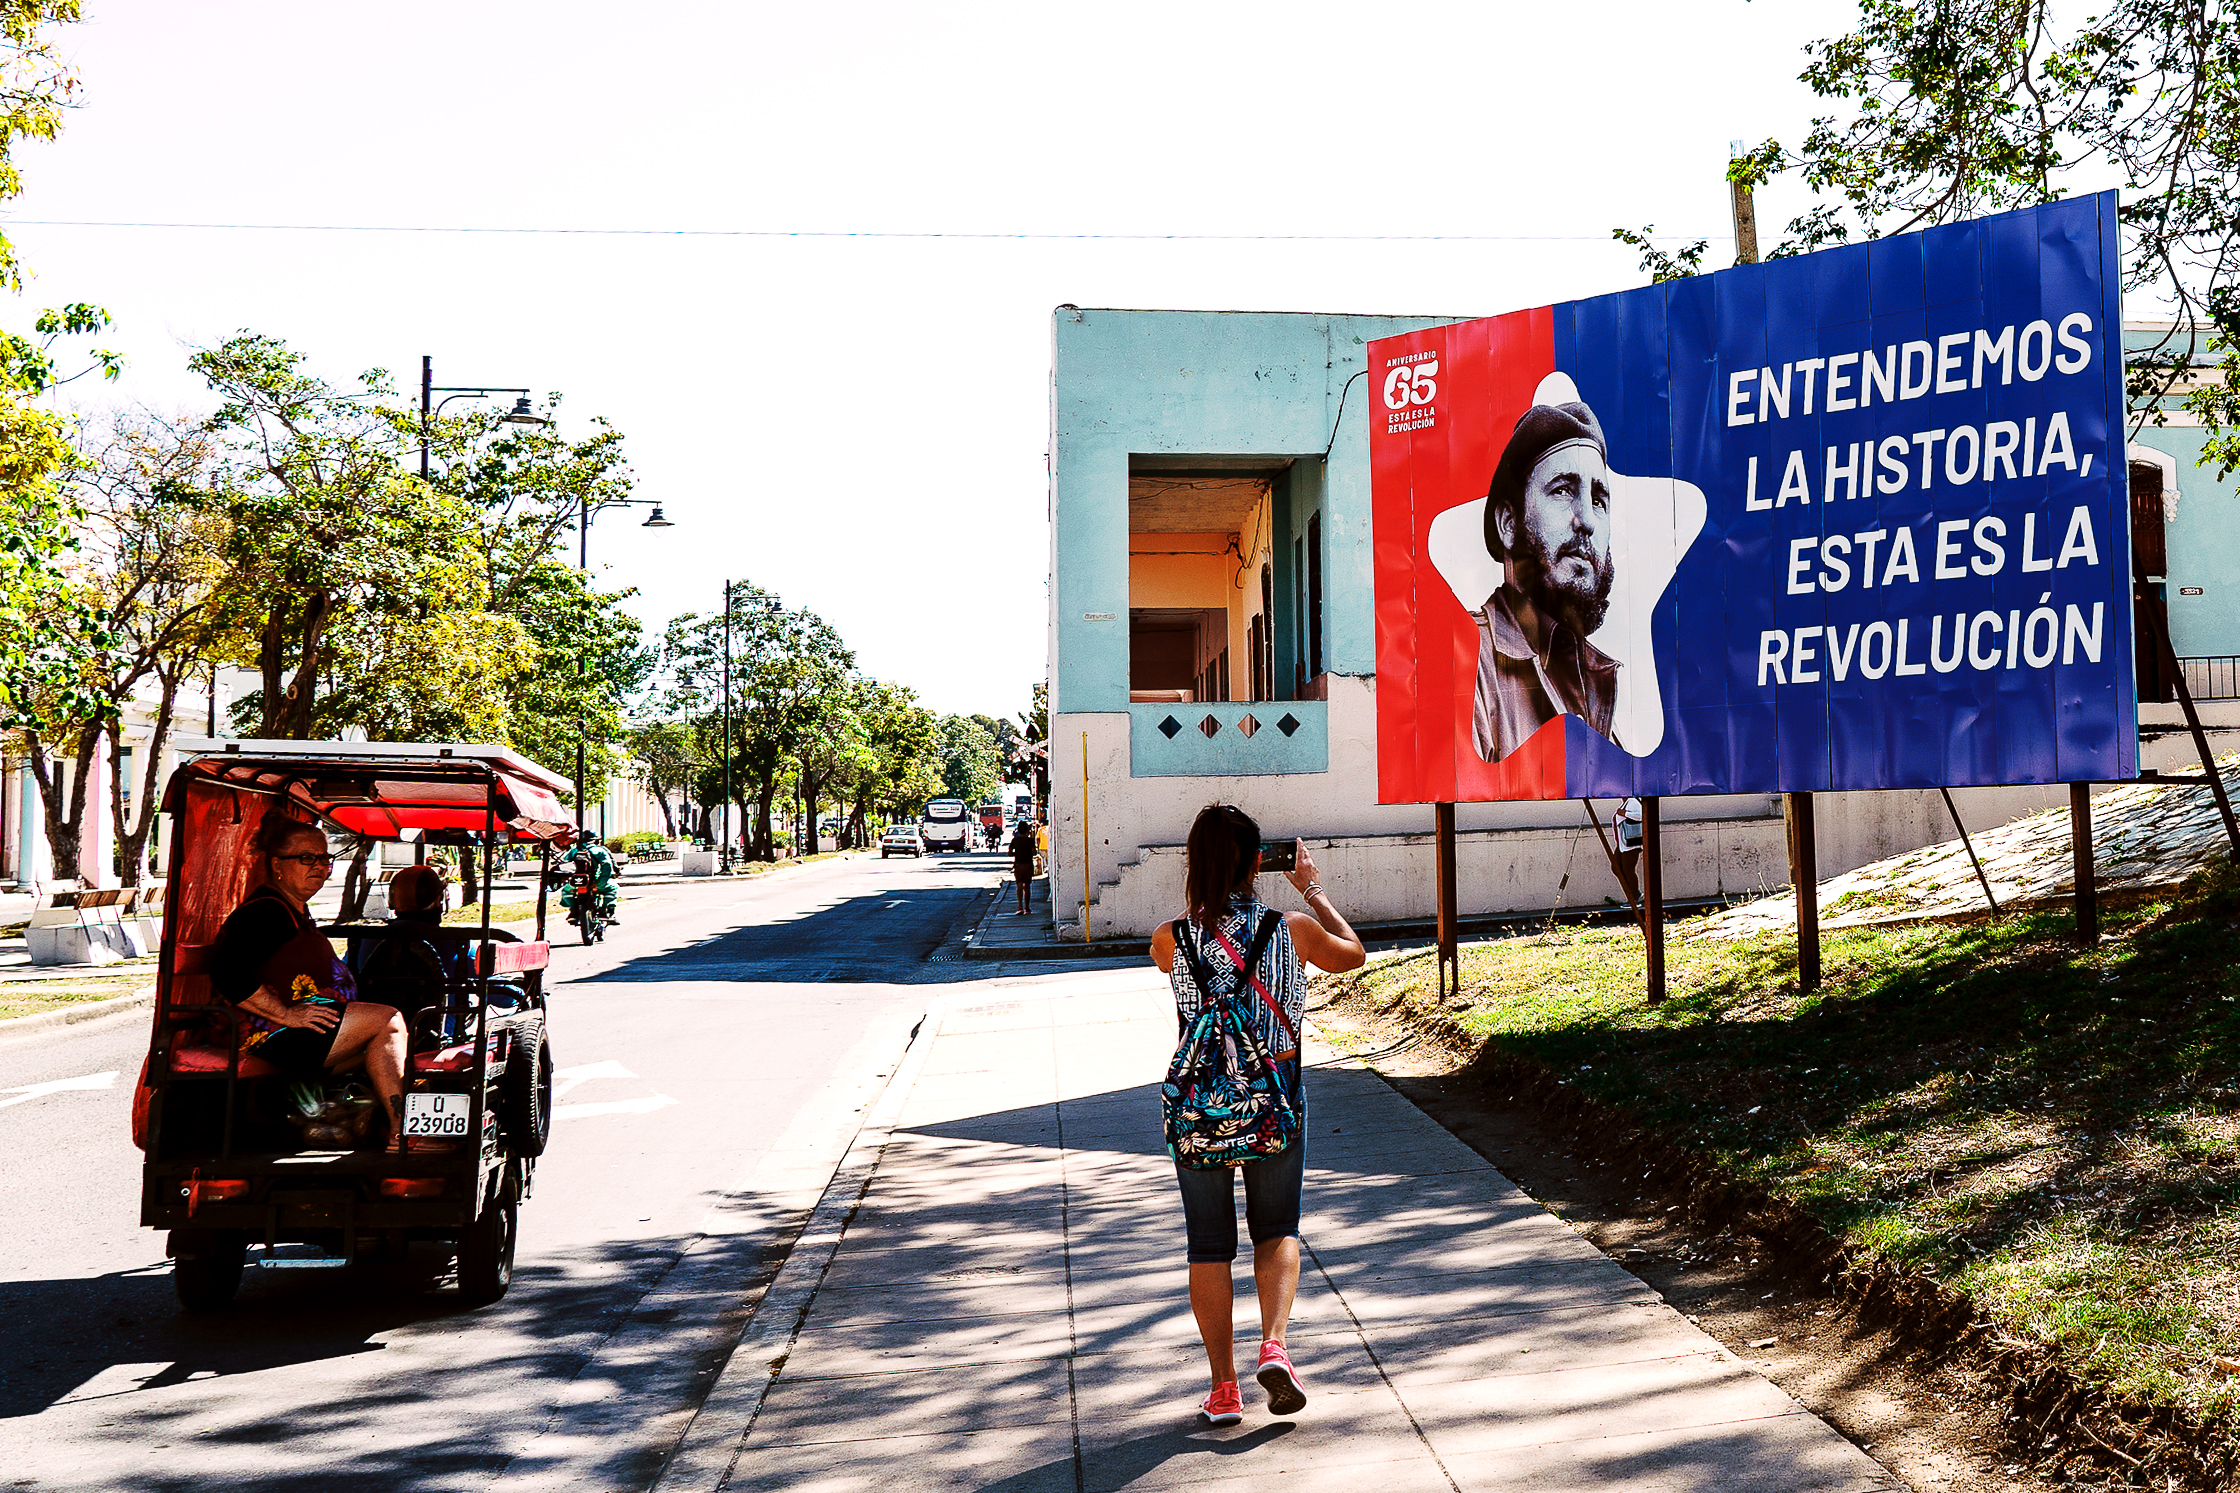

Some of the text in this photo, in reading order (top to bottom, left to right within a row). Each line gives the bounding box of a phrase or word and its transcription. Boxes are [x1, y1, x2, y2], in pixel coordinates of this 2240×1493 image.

[1386, 350, 1437, 367] ANIVERSARIO
[1727, 312, 2093, 427] ENTENDEMOS
[1383, 359, 1439, 410] 65
[1387, 417, 1435, 434] REVOLUCIÓN
[1388, 406, 1436, 423] ESTA ES LA
[1745, 411, 2094, 512] LA HISTORIA,
[1787, 505, 2099, 595] ESTA ES LA
[1757, 591, 2104, 687] REVOLUCIÓN
[408, 1117, 466, 1133] 23908
